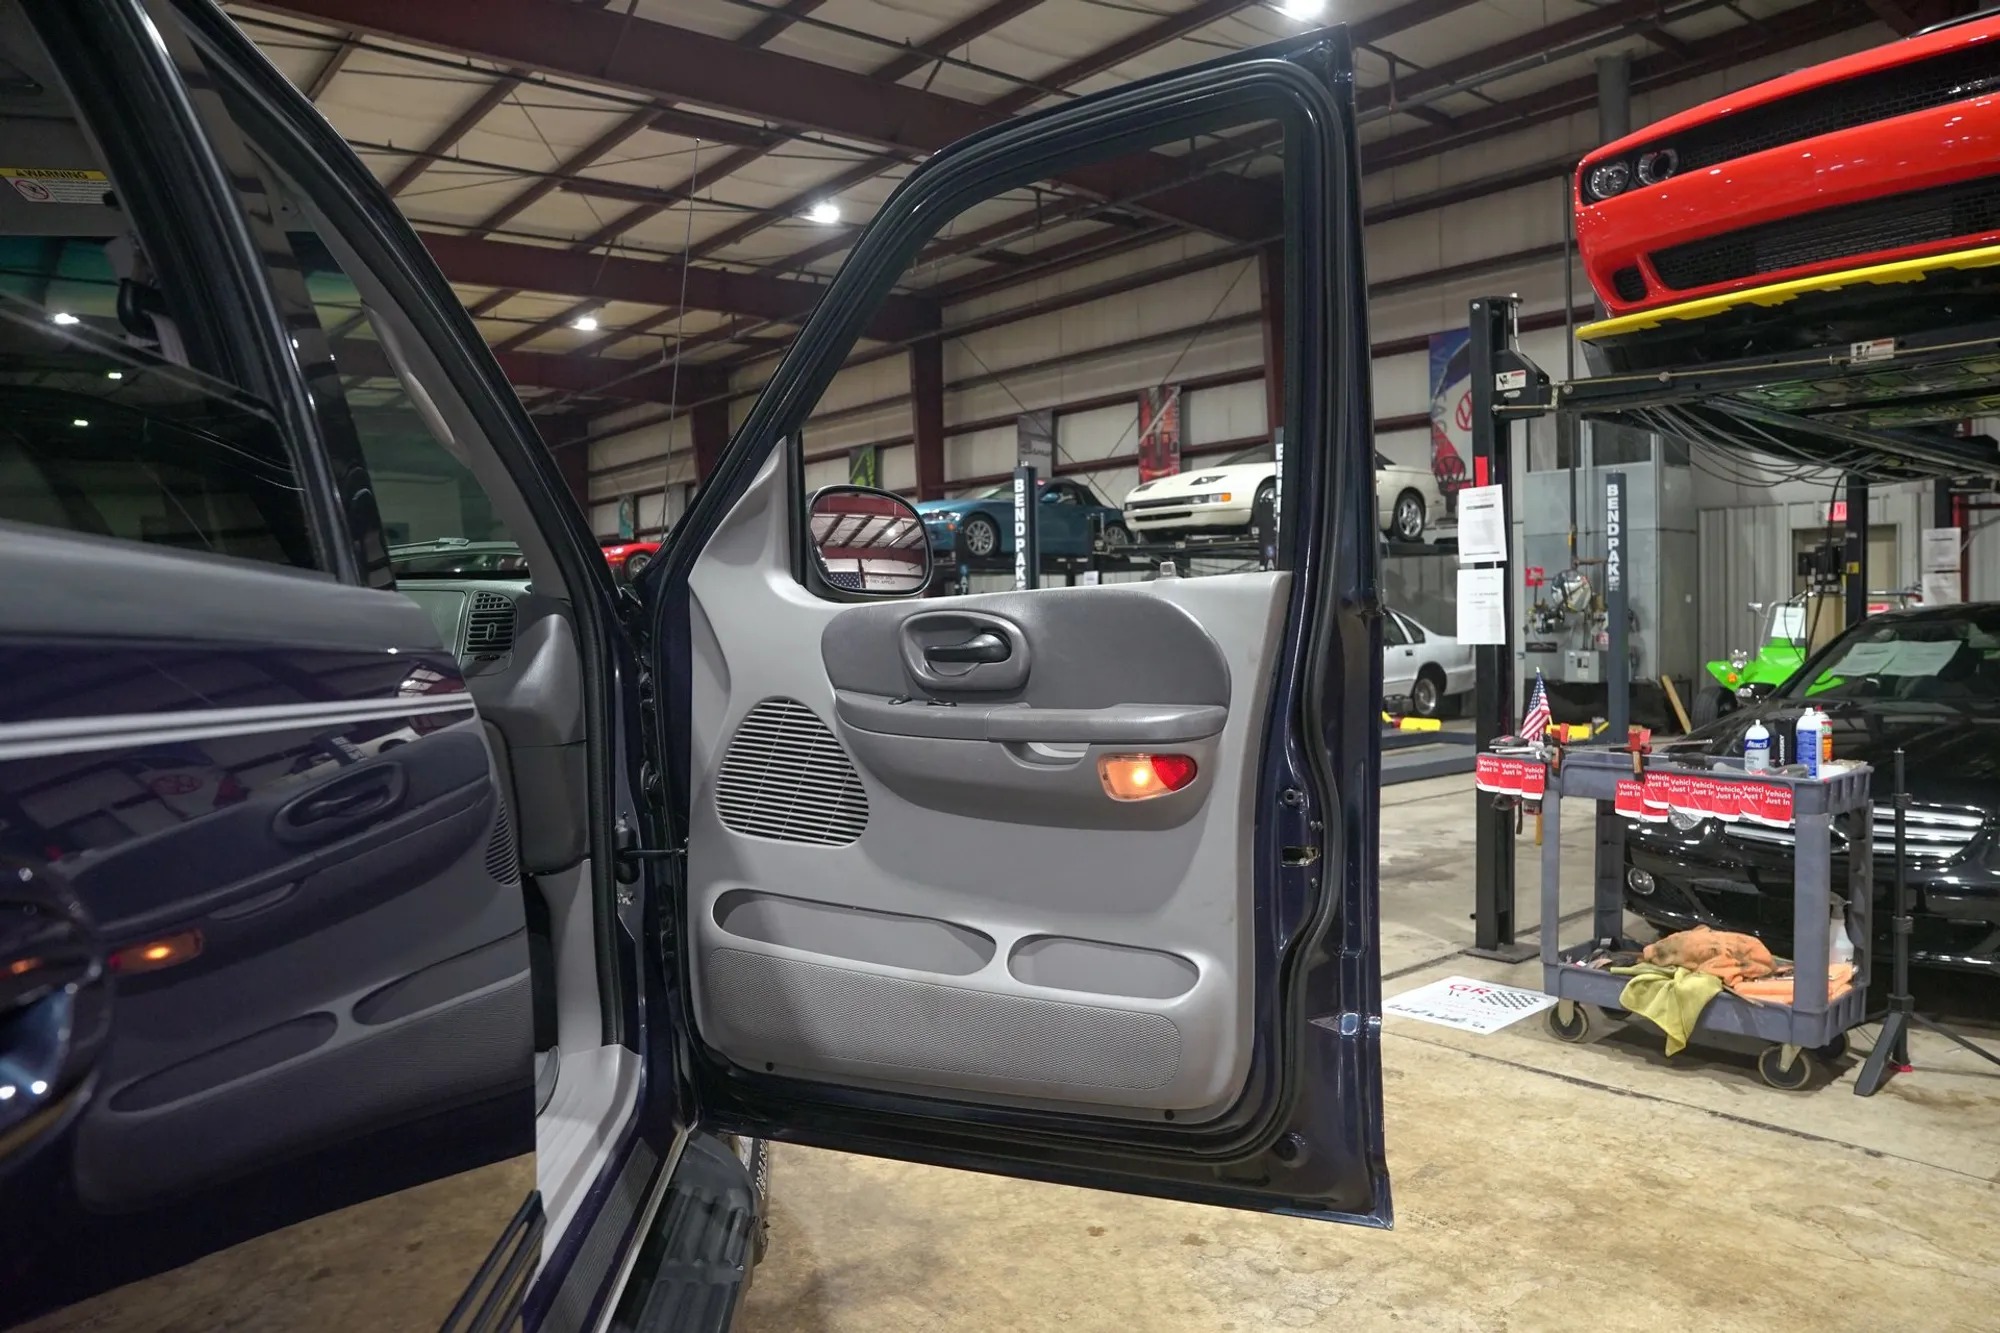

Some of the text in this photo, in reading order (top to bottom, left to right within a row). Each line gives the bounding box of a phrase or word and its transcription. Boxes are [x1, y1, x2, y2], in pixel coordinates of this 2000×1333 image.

[22, 169, 88, 179] WARNING
[1014, 478, 1026, 580] BENDPAK
[1606, 484, 1620, 575] BENDPAK
[1502, 768, 1515, 776] Just
[1647, 780, 1661, 788] Just
[1670, 778, 1691, 787] Vehicl
[1671, 785, 1686, 793] Just
[1691, 788, 1706, 796] Just
[1715, 785, 1740, 793] Vehicle
[1742, 785, 1764, 793] Vehicl
[1715, 792, 1731, 800] Just
[1742, 792, 1758, 801] Just
[1765, 789, 1792, 799] Vehicle
[1765, 797, 1790, 806] Just In
